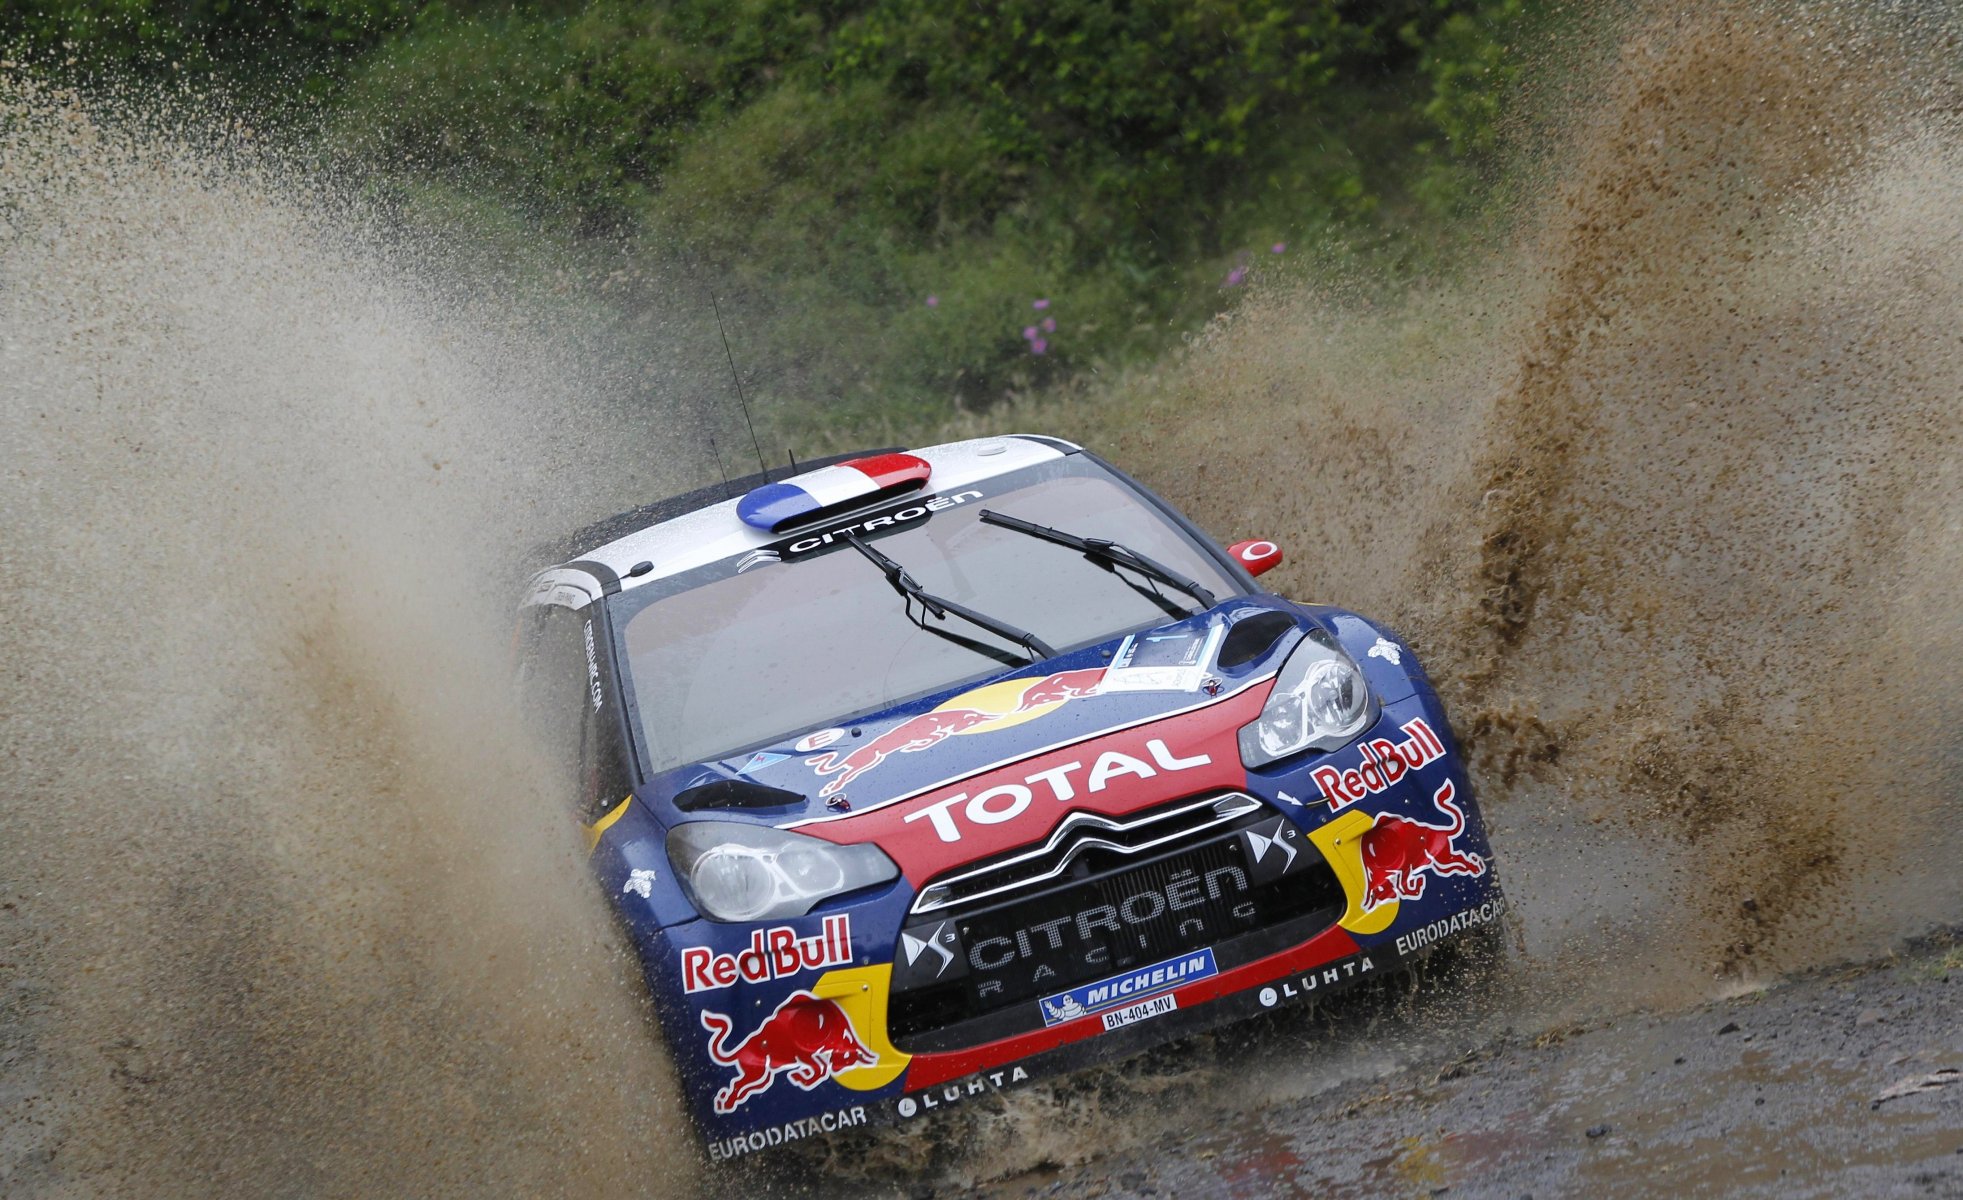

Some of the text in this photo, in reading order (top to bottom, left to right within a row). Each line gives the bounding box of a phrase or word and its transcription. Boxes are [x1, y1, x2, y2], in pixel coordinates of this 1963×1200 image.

[903, 739, 1212, 843] TOTAL
[1395, 896, 1505, 956] EURODATACAR
[1087, 956, 1205, 1005] MICHELIN
[1283, 956, 1375, 998] LUHTA
[1106, 996, 1173, 1028] BN-404-MV
[923, 1066, 1028, 1109] LUHTA
[708, 1106, 867, 1161] EURODATACAR
